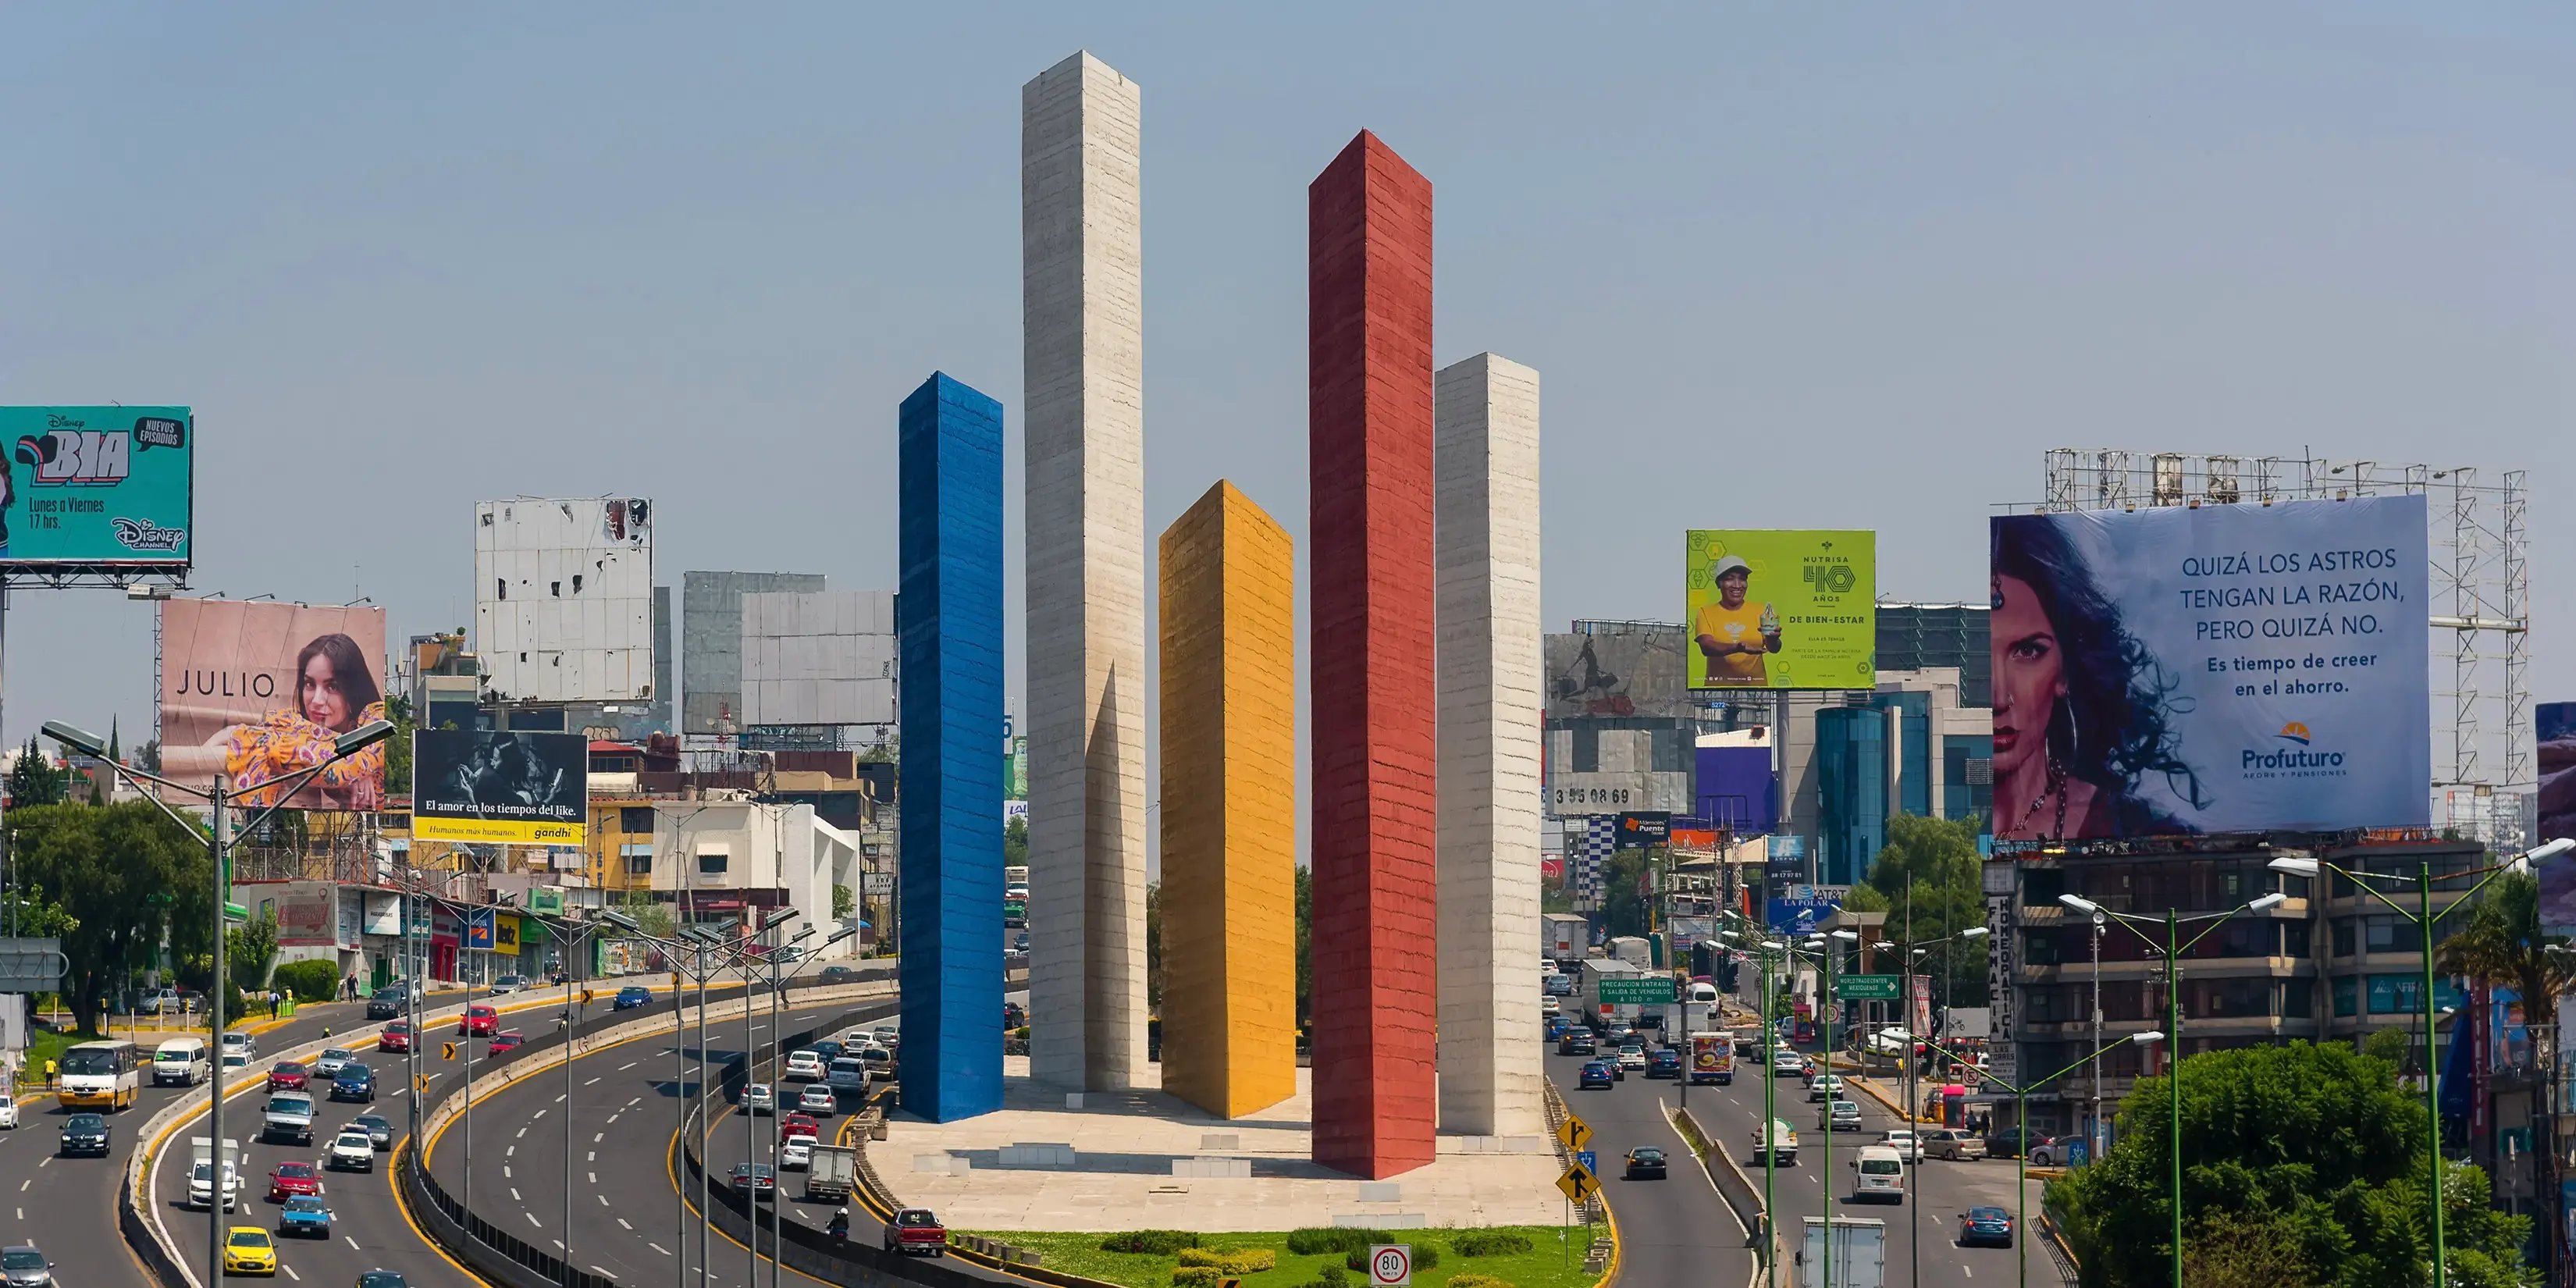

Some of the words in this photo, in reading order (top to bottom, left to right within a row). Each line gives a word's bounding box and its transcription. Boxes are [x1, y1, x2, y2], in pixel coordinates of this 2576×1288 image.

[146, 419, 175, 433] NUEVOS
[140, 431, 178, 445] EPISODIOS
[37, 430, 130, 482] BIA
[29, 497, 61, 512] Lunes
[60, 502, 66, 512] a
[68, 497, 104, 512] Viernes
[30, 514, 40, 528] 17
[43, 514, 61, 529] hrs.
[2183, 551, 2250, 576] QUIZÁ
[2259, 553, 2300, 573] LOS
[2308, 549, 2396, 571] ASTROS
[1803, 565, 1856, 592] 40
[2180, 587, 2274, 608] TENGAN
[2283, 585, 2311, 604] LA
[2319, 578, 2404, 603] RAZÓN,
[2197, 620, 2254, 640] PERO
[2261, 613, 2333, 638] QUIZÁ
[2342, 614, 2382, 635] NO.
[2208, 657, 2226, 671] Es
[2233, 656, 2295, 674] tiempo
[2303, 653, 2325, 668] de
[2332, 654, 2378, 667] creer
[176, 670, 275, 698] JULIO
[2236, 685, 2255, 696] en
[2263, 679, 2278, 695] el
[2286, 679, 2349, 695] ahorro.
[2242, 749, 2343, 769] Profuturo
[426, 800, 436, 810] El
[438, 803, 464, 812] amor
[481, 802, 495, 813] los
[498, 805, 536, 817] tiempos
[539, 805, 553, 815] del
[556, 805, 576, 817] like.
[482, 828, 517, 837] humanos.
[535, 827, 571, 840] gandhi
[1817, 890, 1847, 899] AT&T
[1989, 907, 1998, 1034] FARMACIA
[2000, 899, 2010, 1040] HOMEOPATICA
[1382, 1255, 1399, 1269] 80
